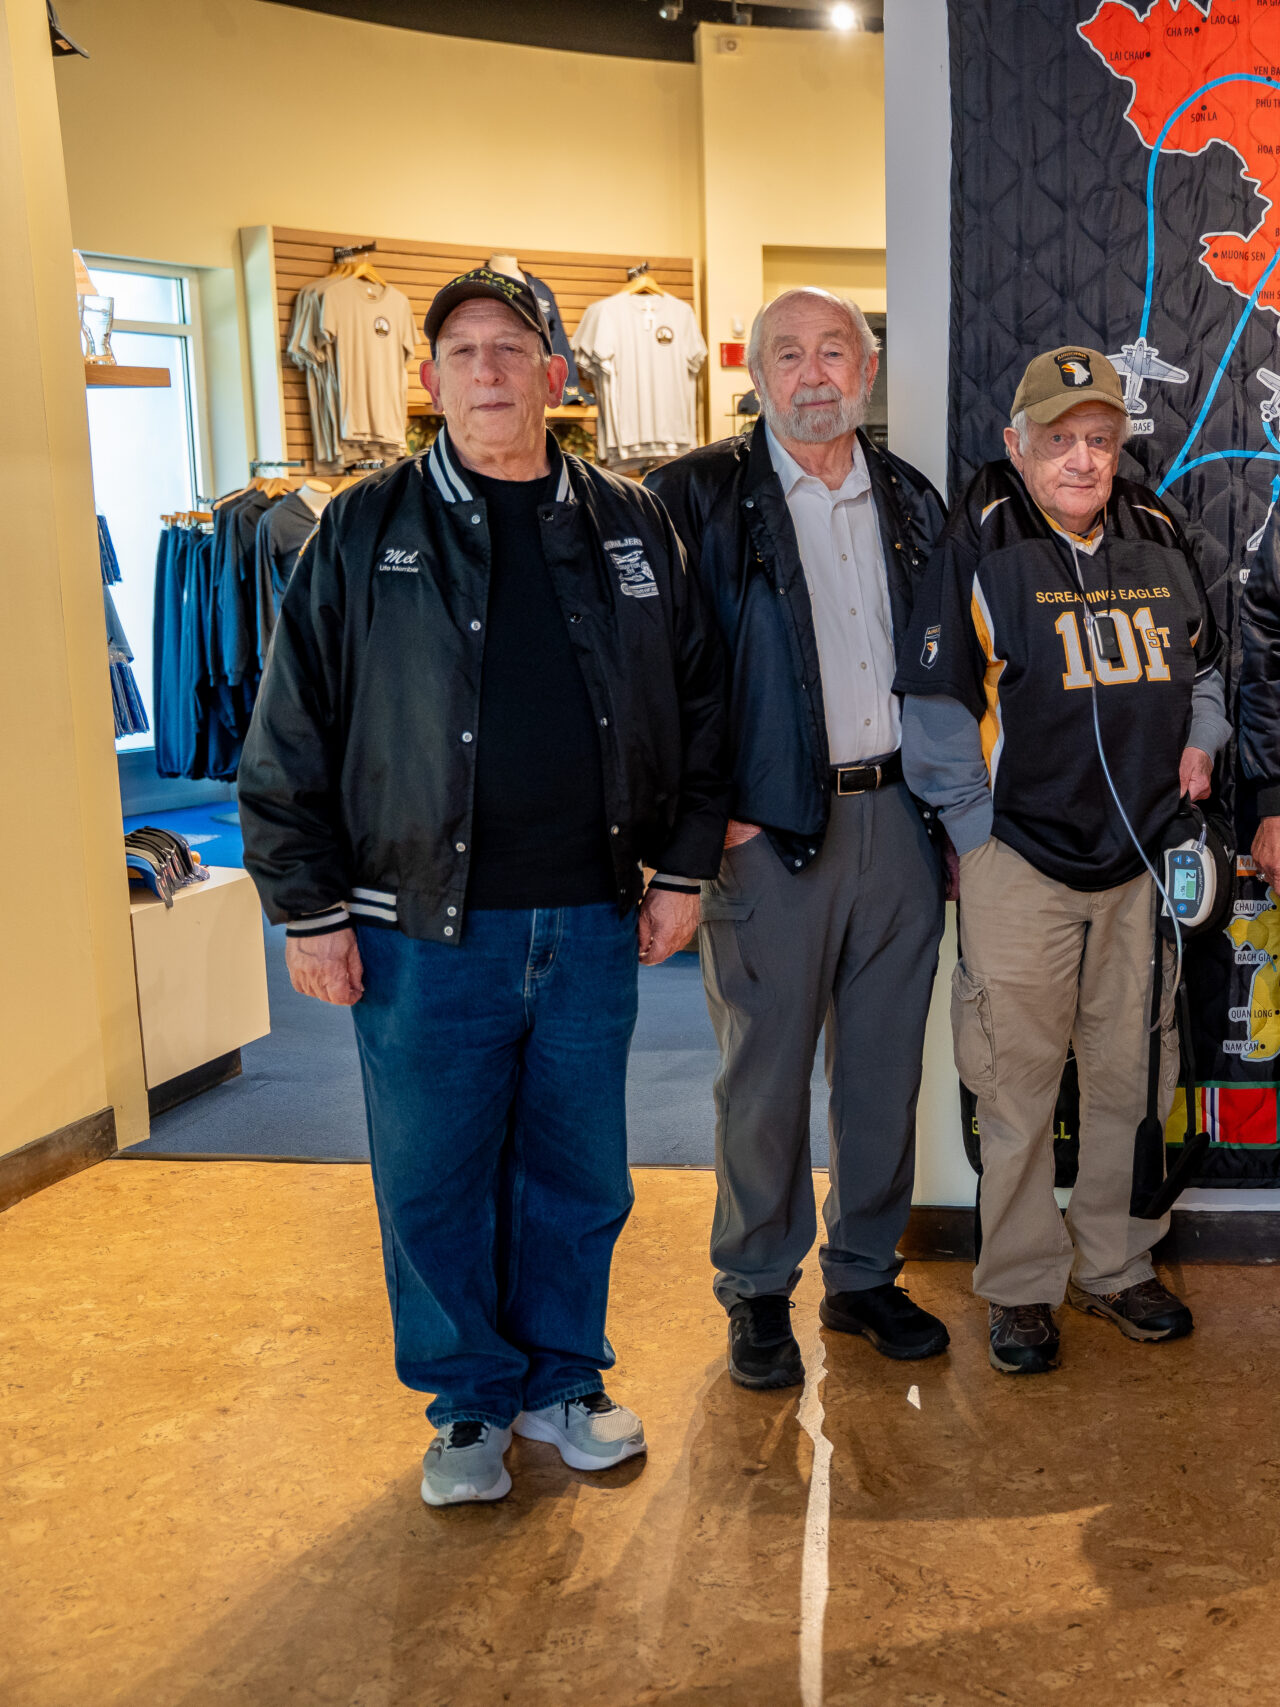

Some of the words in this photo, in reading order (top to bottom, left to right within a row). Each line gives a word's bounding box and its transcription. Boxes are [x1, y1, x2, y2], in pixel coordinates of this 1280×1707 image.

[1211, 16, 1225, 24] LAO
[1228, 15, 1240, 24] CAI
[1167, 28, 1182, 37] CHA
[1184, 27, 1194, 36] PA
[1110, 52, 1122, 61] LAI
[1124, 51, 1145, 60] CHAU
[1254, 66, 1268, 75] YEN
[1256, 99, 1272, 108] PHU
[1191, 113, 1206, 123] SON
[1208, 113, 1217, 122] LA
[1257, 145, 1273, 155] HOA
[1221, 251, 1249, 260] MUONG
[1251, 252, 1265, 261] SEN
[1256, 290, 1275, 299] VINH
[1133, 422, 1151, 432] BASE
[384, 549, 419, 565] Mel
[392, 565, 419, 573] Member
[1035, 590, 1117, 603] SCREAMING
[1119, 587, 1171, 600] EAGLES
[1235, 903, 1255, 912] CHAU
[1256, 903, 1272, 912] DOC
[1238, 953, 1256, 961] RACH
[1258, 953, 1271, 962] GIA
[1231, 1010, 1251, 1019] QUAN
[1254, 1010, 1272, 1018] LONG
[1225, 1043, 1241, 1051] NAM
[1244, 1043, 1259, 1051] CAN
